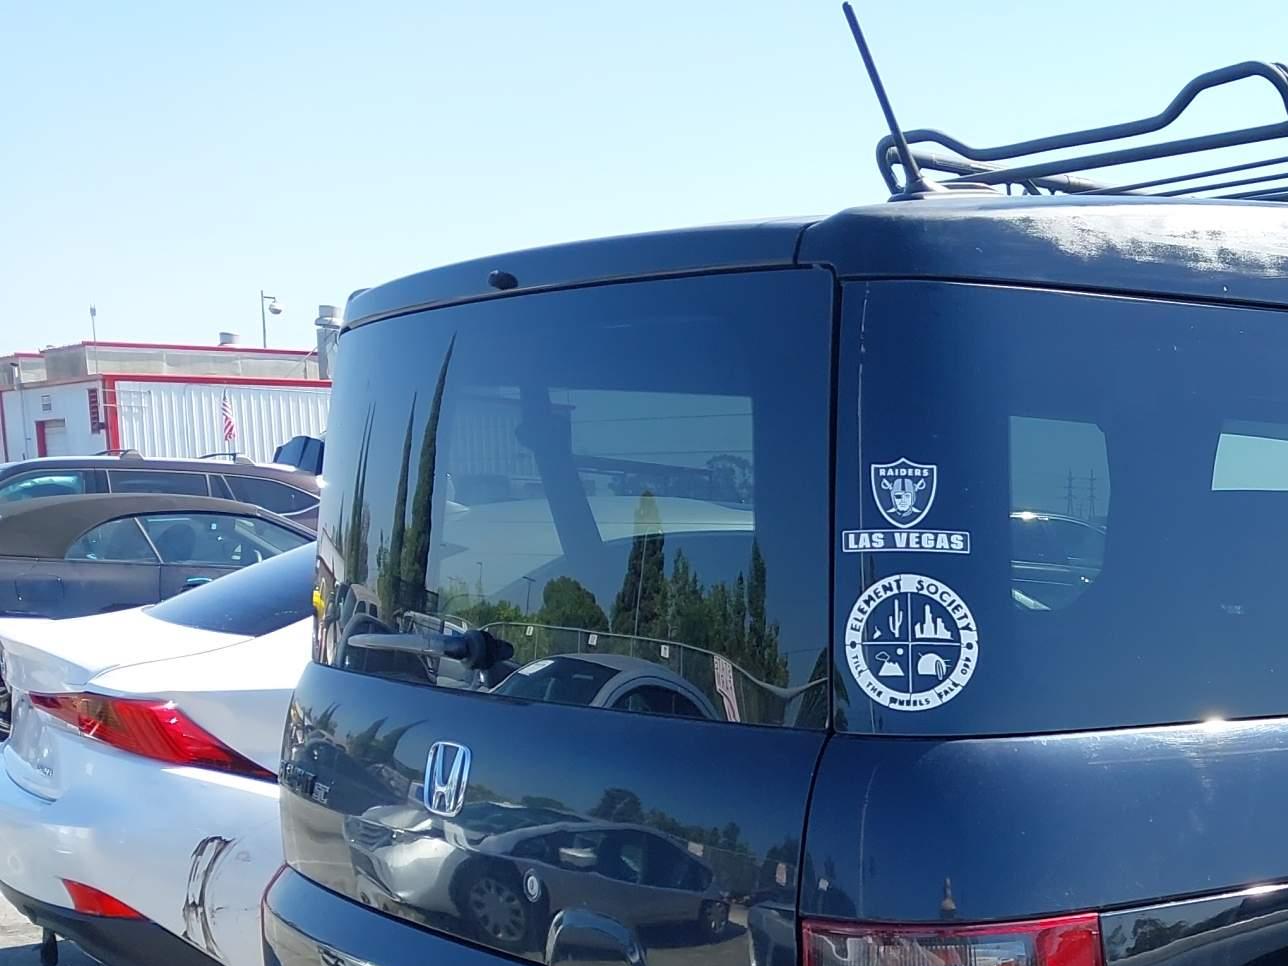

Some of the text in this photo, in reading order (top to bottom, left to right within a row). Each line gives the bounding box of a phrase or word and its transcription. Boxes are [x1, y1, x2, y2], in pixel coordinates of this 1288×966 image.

[879, 468, 929, 477] RAIDERS
[848, 532, 964, 549] LAS VEGAS
[850, 578, 975, 632] ELEMENT SOCIETY
[851, 654, 867, 675] TILL
[866, 681, 884, 698] THE
[888, 696, 931, 707] WHEELS
[936, 679, 962, 700] FALL
